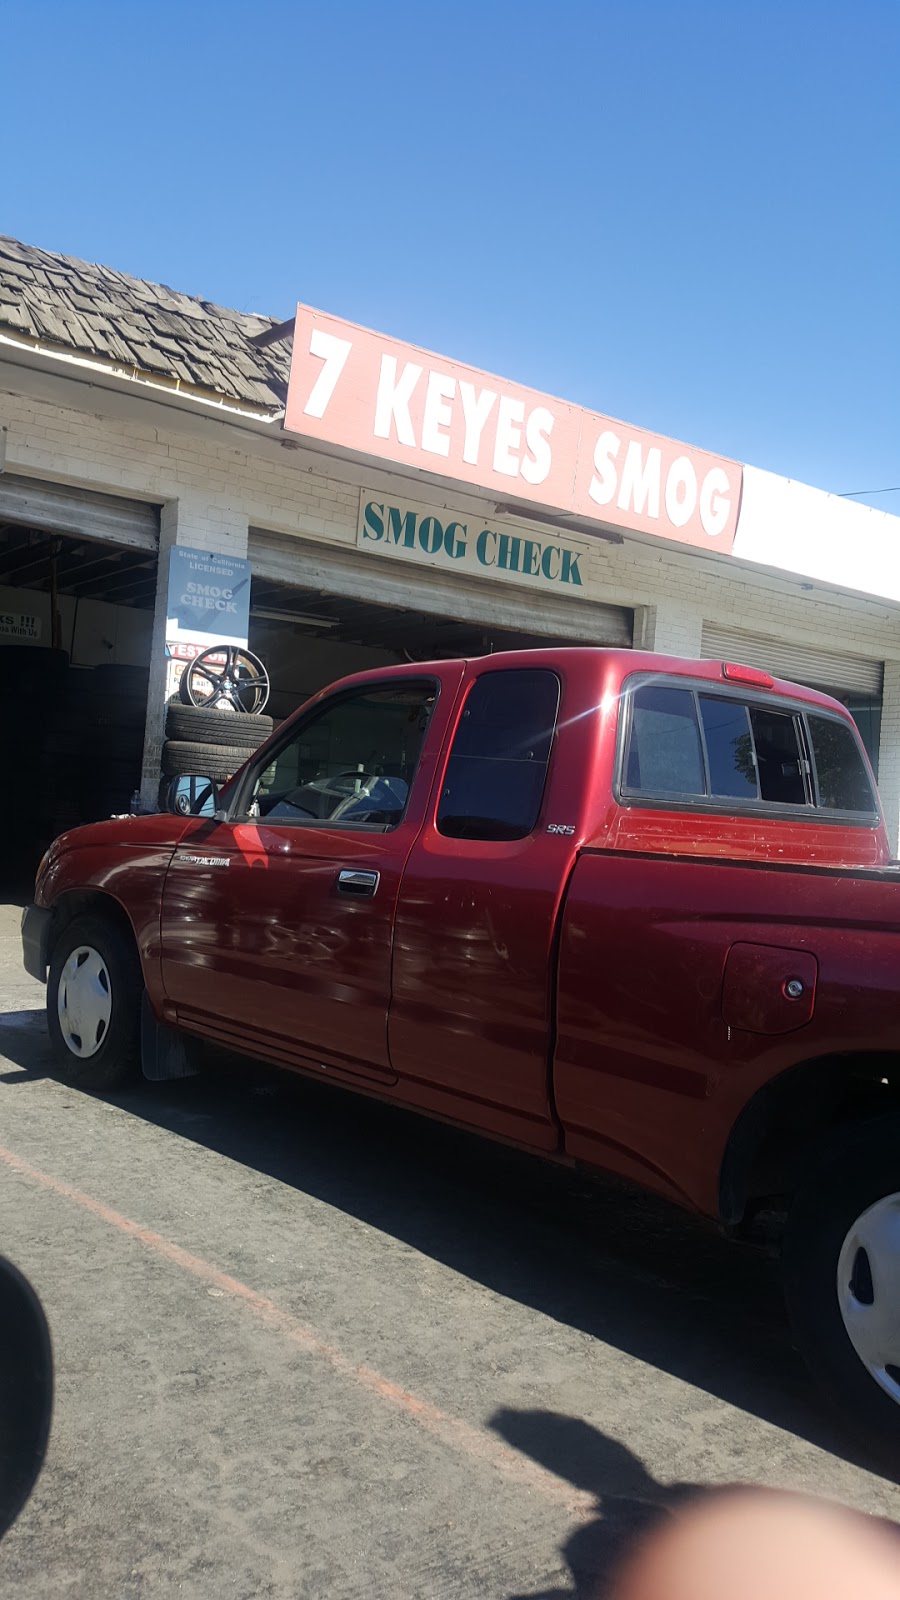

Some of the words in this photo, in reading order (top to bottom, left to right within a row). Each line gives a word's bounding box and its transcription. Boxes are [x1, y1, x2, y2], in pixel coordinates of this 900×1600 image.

[303, 328, 352, 419] 7
[373, 353, 554, 485] KEYES
[589, 431, 731, 537] SMOG
[363, 501, 468, 559] SMOG
[476, 530, 584, 586] CHECK
[178, 550, 198, 560] State
[211, 557, 245, 569] California
[189, 561, 234, 577] LICENSED
[186, 582, 234, 600] SMOG
[180, 593, 238, 614] CHECK
